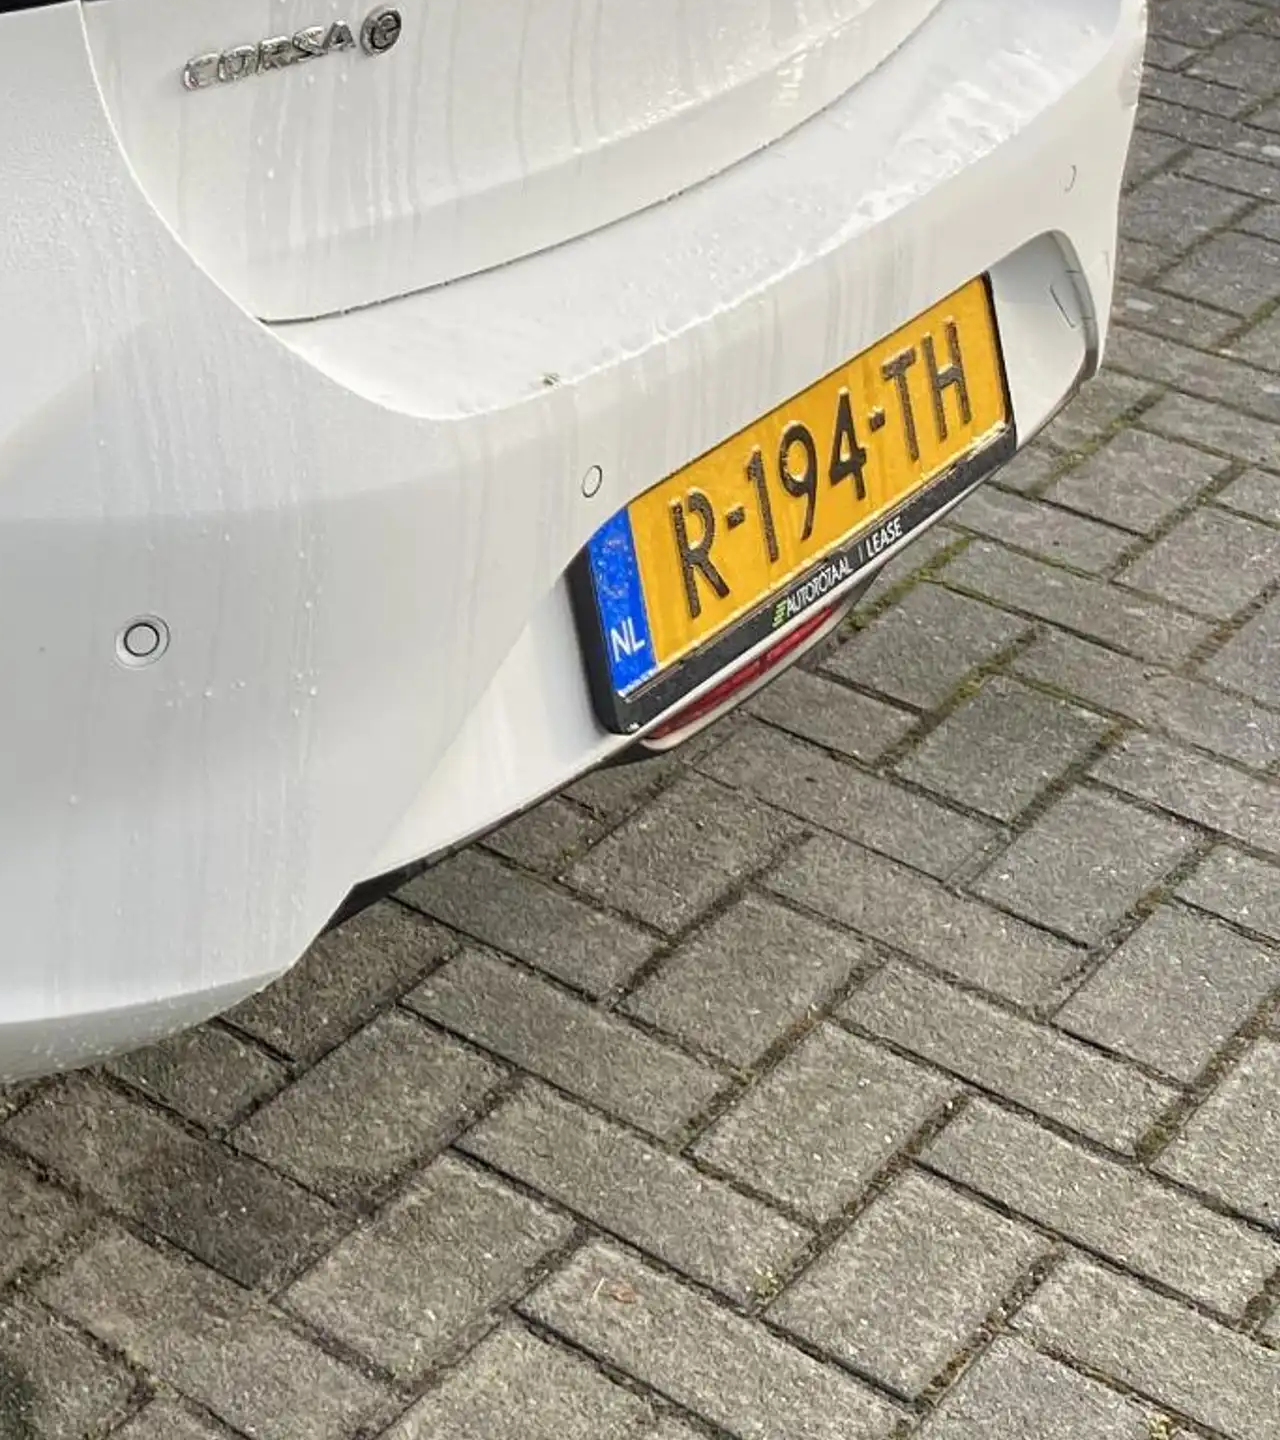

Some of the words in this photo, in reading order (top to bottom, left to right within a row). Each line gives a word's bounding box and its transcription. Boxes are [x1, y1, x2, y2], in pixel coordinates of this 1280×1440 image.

[181, 19, 357, 91] CORSA
[668, 314, 974, 620] R-194-TH
[785, 556, 854, 617] AUTOTOTAAL
[865, 516, 903, 558] LEASE
[609, 616, 646, 663] NL
